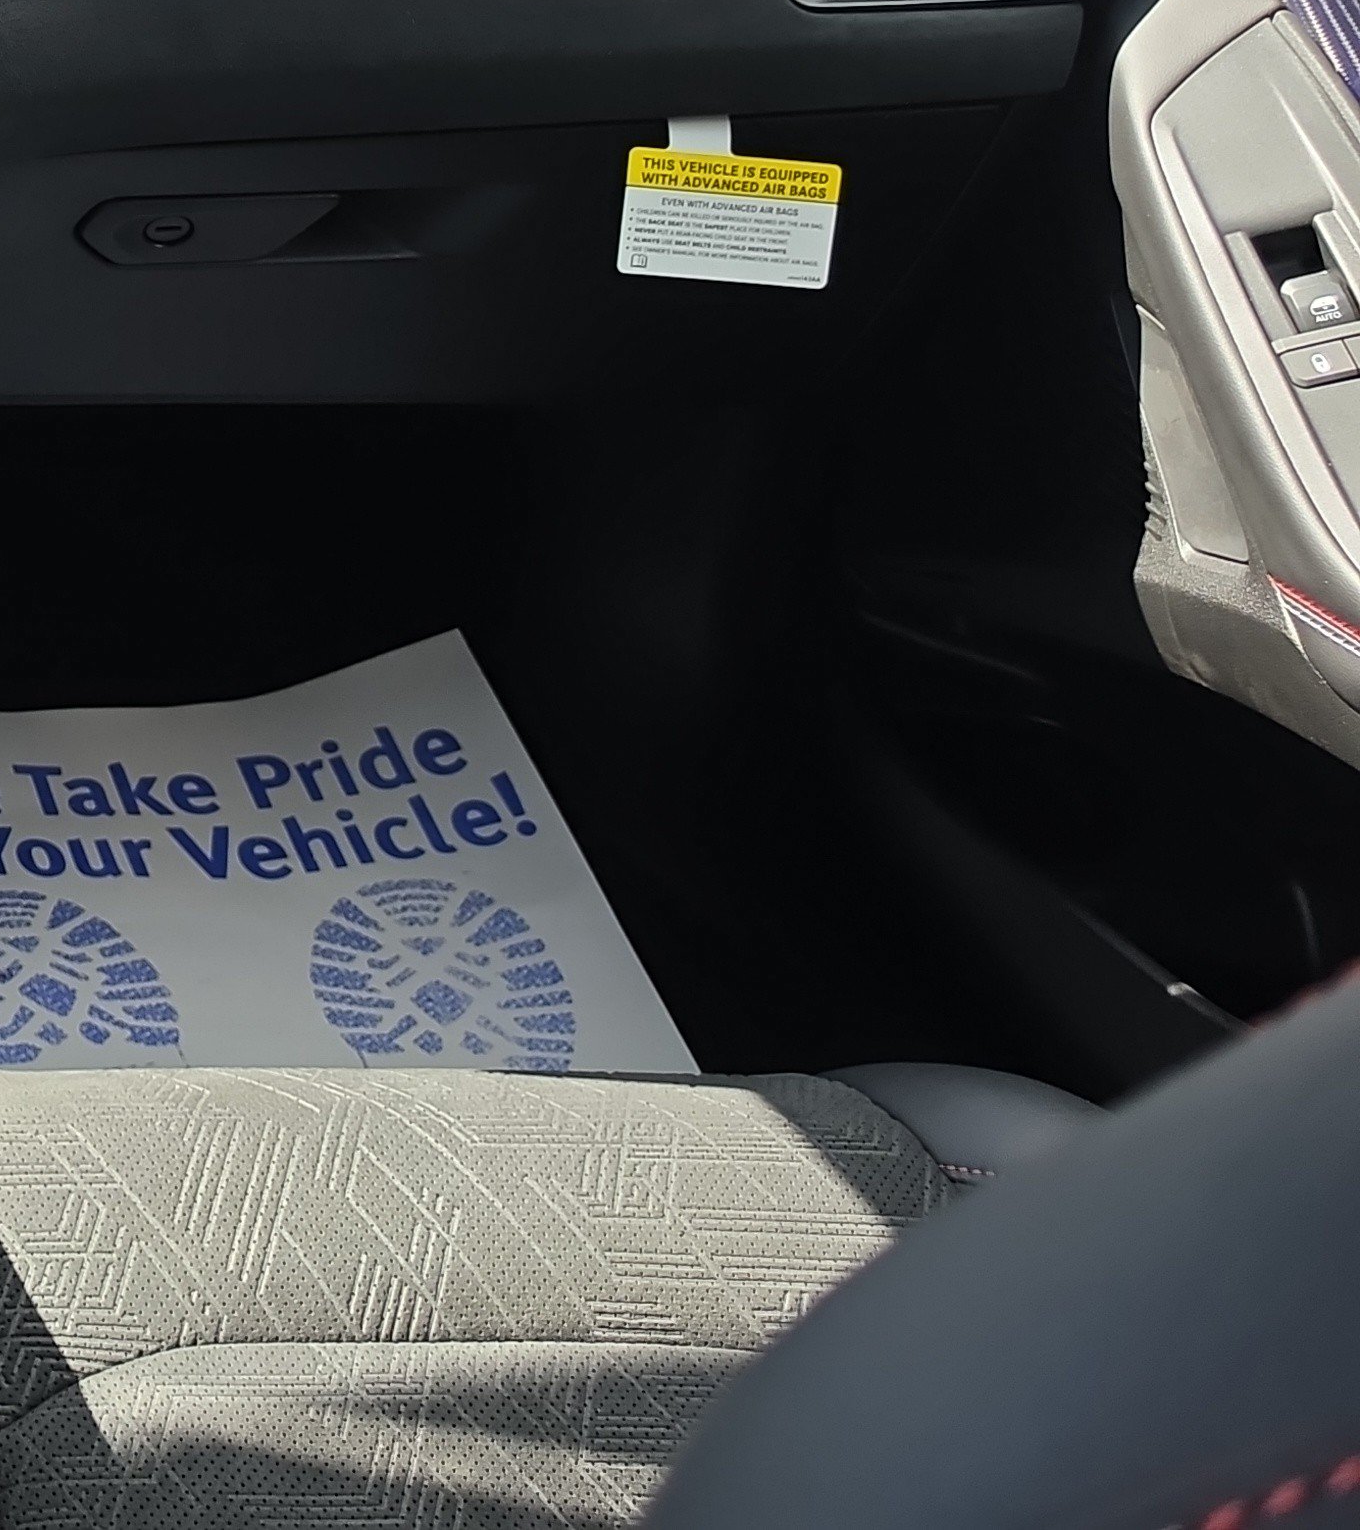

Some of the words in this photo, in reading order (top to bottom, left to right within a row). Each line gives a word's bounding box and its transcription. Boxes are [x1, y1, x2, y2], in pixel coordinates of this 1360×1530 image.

[643, 157, 675, 171] THIS
[679, 160, 738, 177] VEHICLE
[742, 166, 755, 178] IS
[758, 167, 829, 185] EQUIPPED
[640, 172, 677, 186] WITH
[682, 176, 760, 193] ADVANCED
[762, 181, 786, 195] AIR
[789, 184, 827, 199] BAGS
[661, 197, 685, 207] EVEN
[687, 199, 709, 209] WITH
[711, 202, 757, 214] ADVANCED
[759, 206, 774, 215] AIR
[776, 207, 799, 217] BAGS
[1316, 311, 1343, 323] AUTO
[13, 762, 221, 817] Take
[236, 724, 469, 811] Pride
[167, 770, 538, 880] Vehicle!
